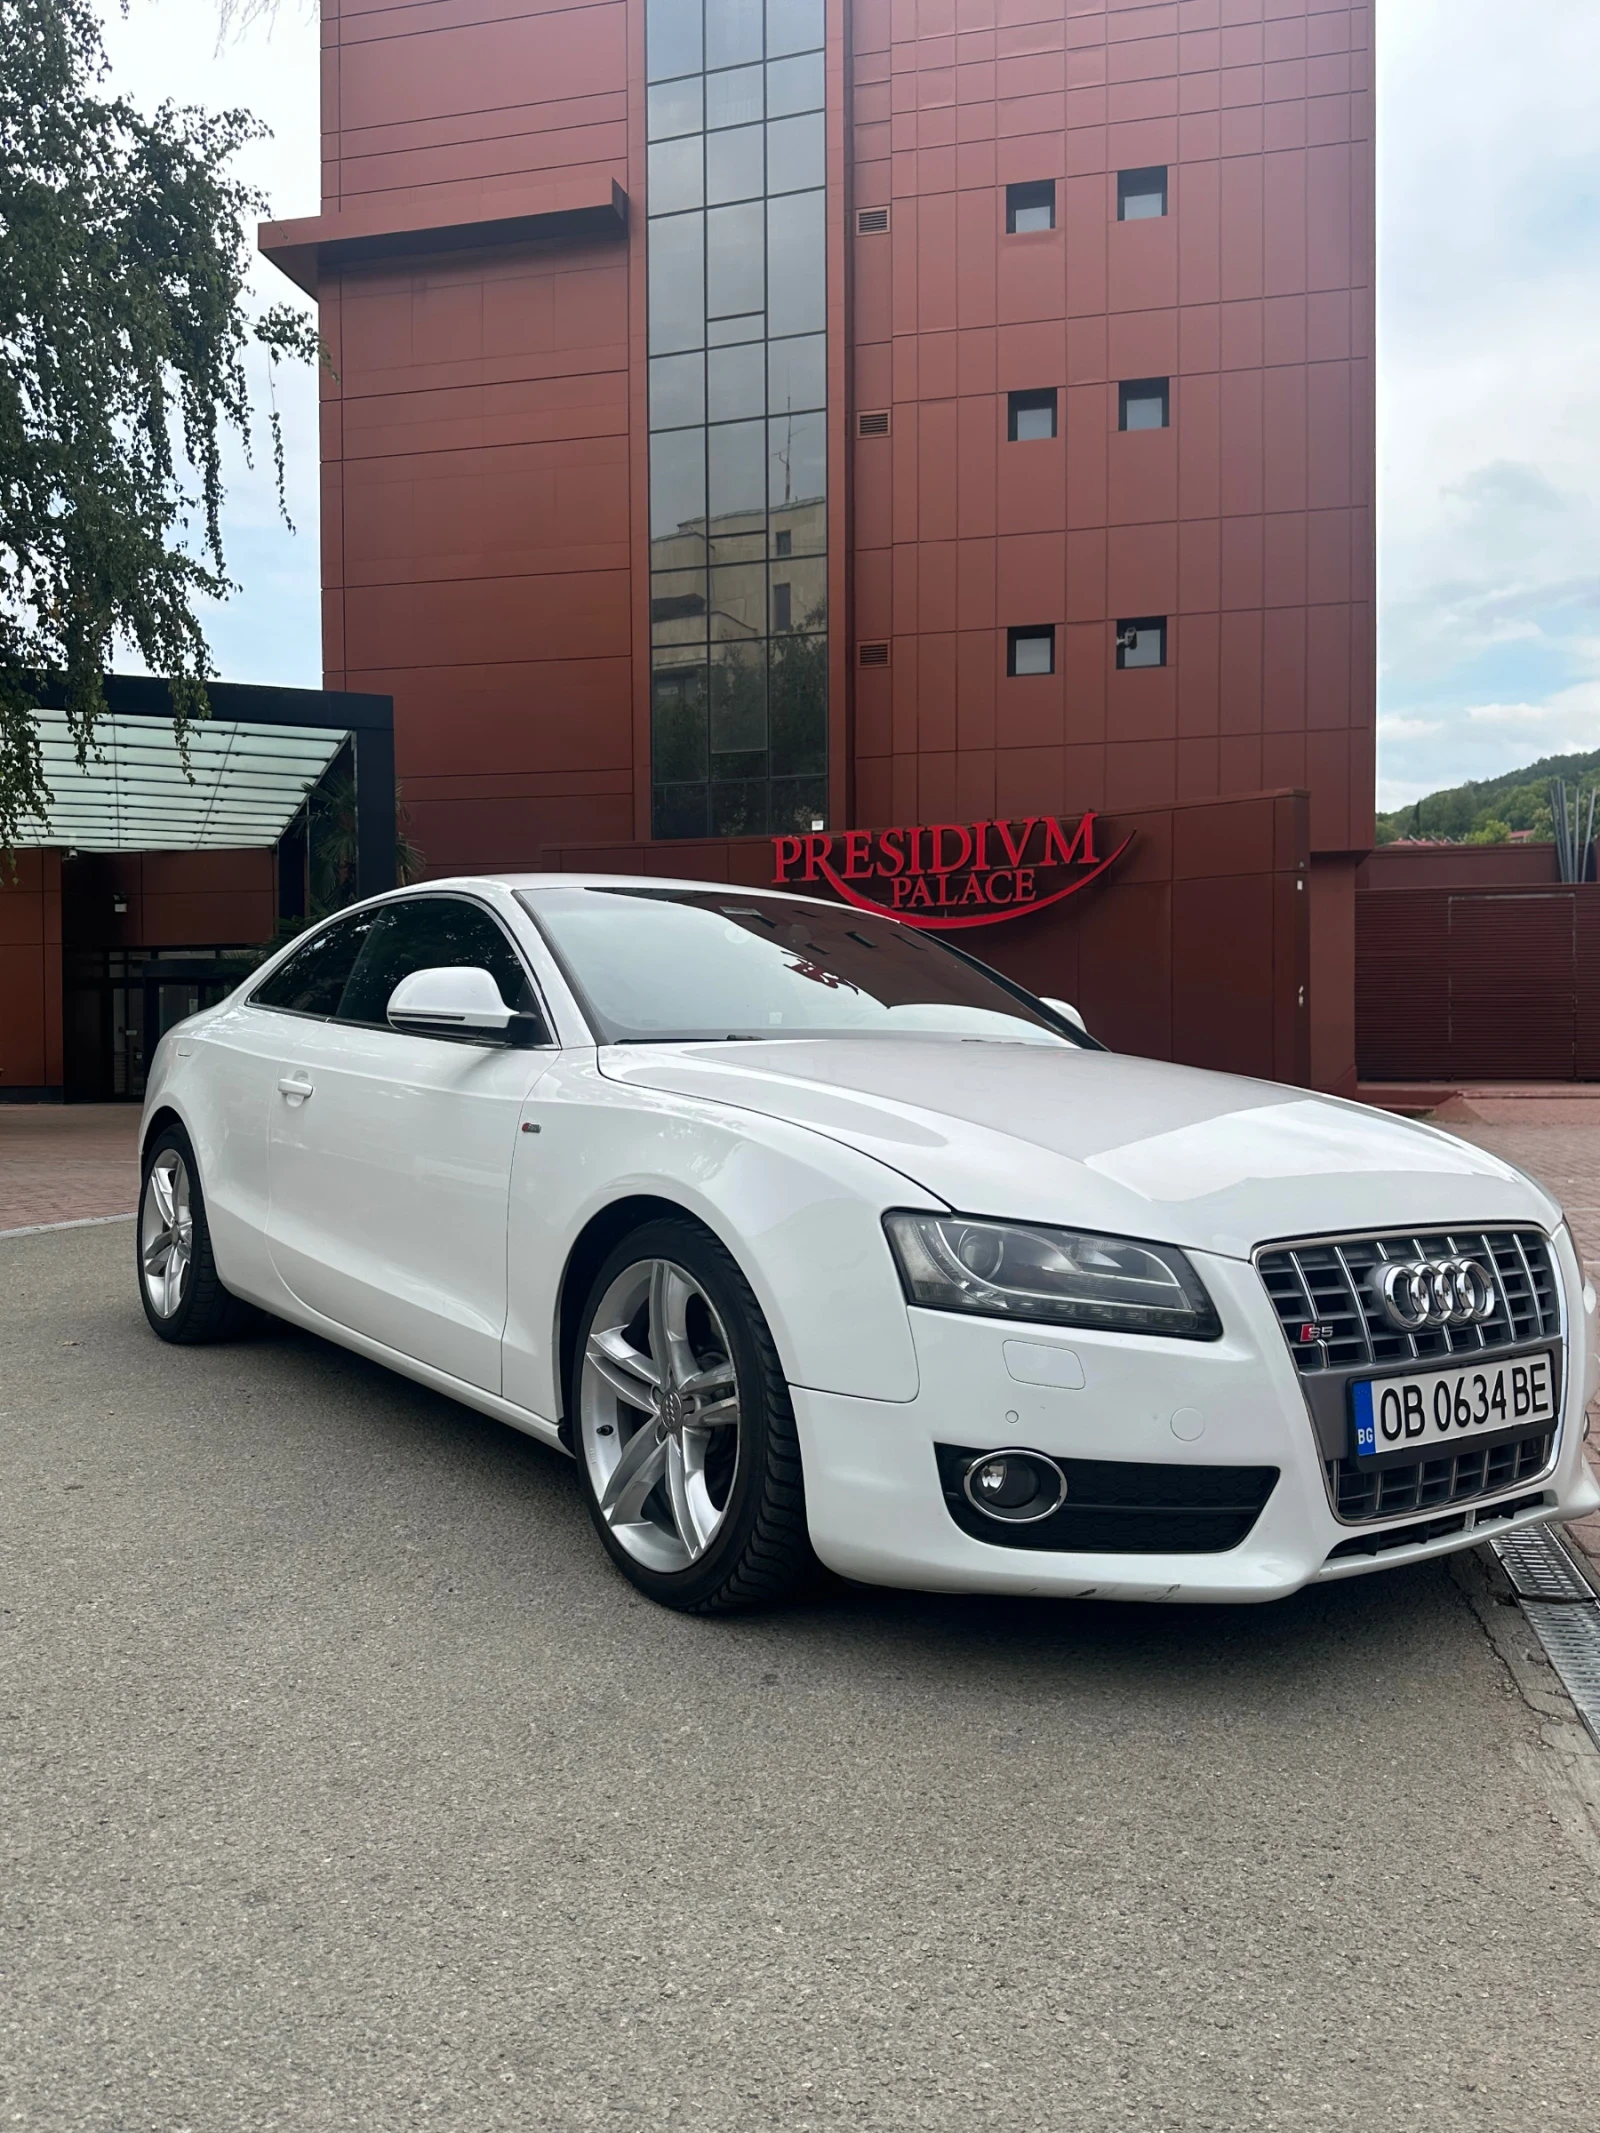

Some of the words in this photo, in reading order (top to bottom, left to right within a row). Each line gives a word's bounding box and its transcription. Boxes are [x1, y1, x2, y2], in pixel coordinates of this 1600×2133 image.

[771, 812, 1099, 884] PRESIDIVM
[890, 868, 1036, 909] PALACE
[1308, 1326, 1333, 1339] S5
[1380, 1384, 1426, 1441] OB
[1433, 1370, 1507, 1432] 0634
[1512, 1362, 1549, 1418] BE
[1357, 1427, 1374, 1445] BG
